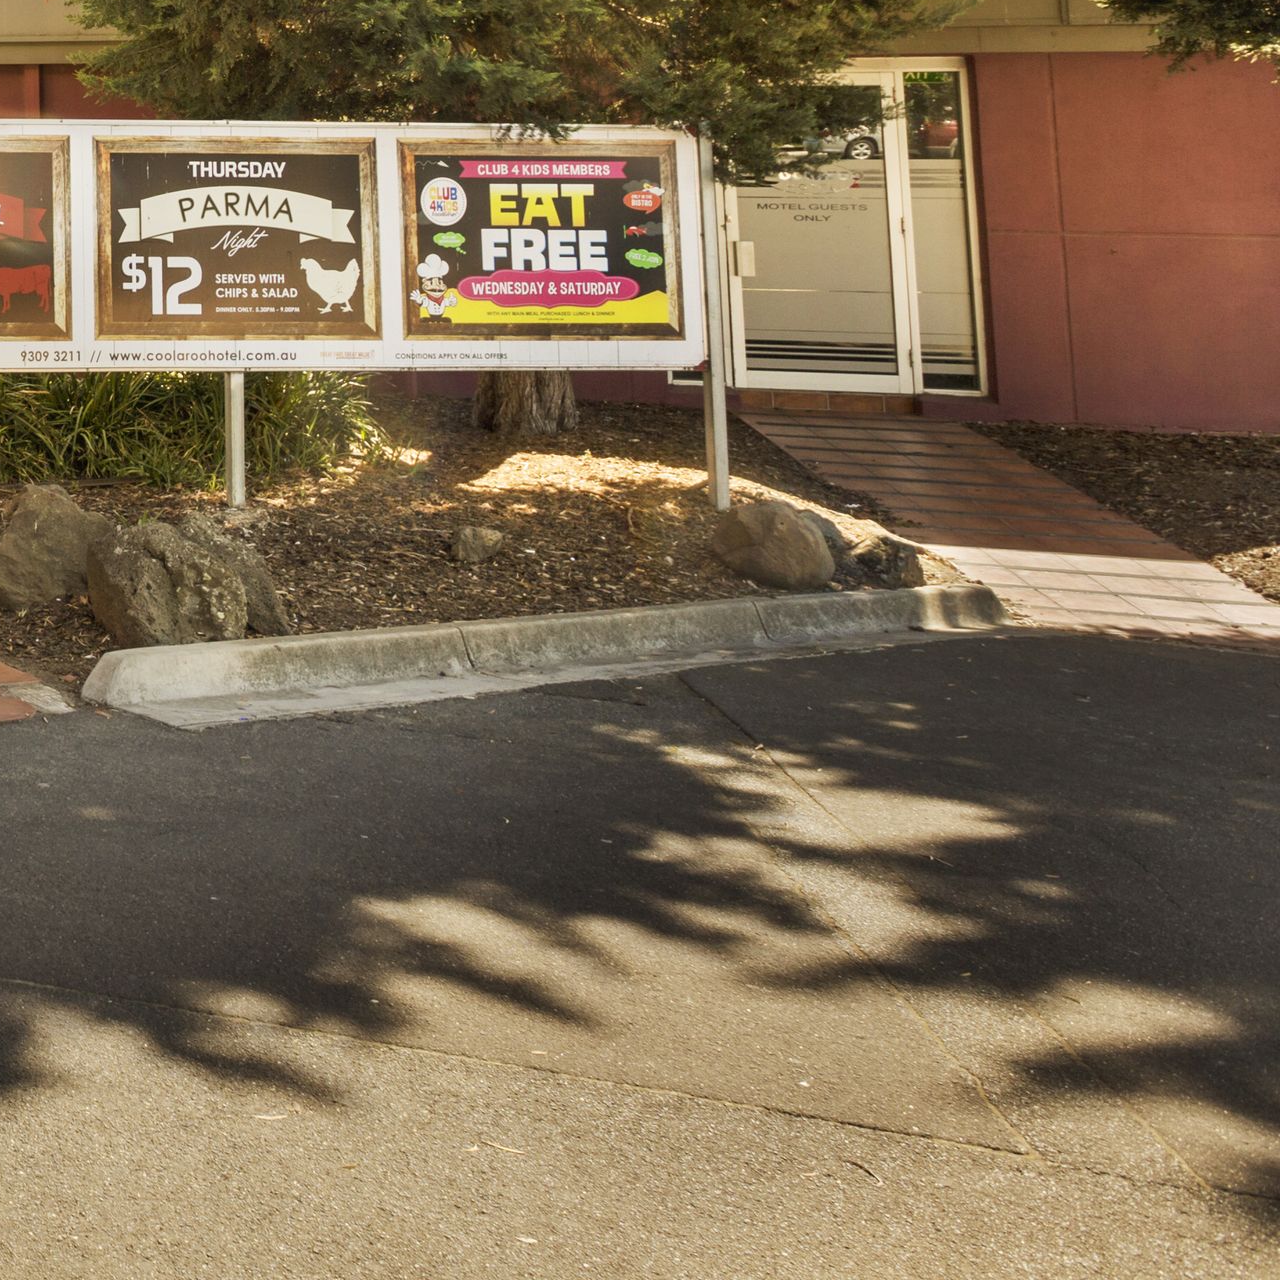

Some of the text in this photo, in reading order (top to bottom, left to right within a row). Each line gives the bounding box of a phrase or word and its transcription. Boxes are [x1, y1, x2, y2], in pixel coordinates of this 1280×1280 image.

[189, 161, 286, 178] THURSDAY
[477, 164, 610, 176] CLUB 4 KIDS MEMBERS
[429, 187, 458, 200] CLUB
[178, 192, 293, 223] PARMA
[489, 183, 594, 227] EAT
[631, 199, 653, 207] BISTRO
[808, 203, 868, 211] GUESTS
[793, 214, 831, 222] ONLY
[210, 227, 268, 257] Night
[480, 228, 609, 272] FREE
[121, 253, 203, 315] $12
[215, 273, 285, 284] SERVED WITH
[215, 288, 298, 298] CHIPS & SALAD
[471, 281, 621, 295] WEDNESDAY & SATURDAY
[20, 350, 49, 362] 9309
[53, 350, 82, 362] 3211
[109, 349, 297, 362] www.coolaroohotel.com.au
